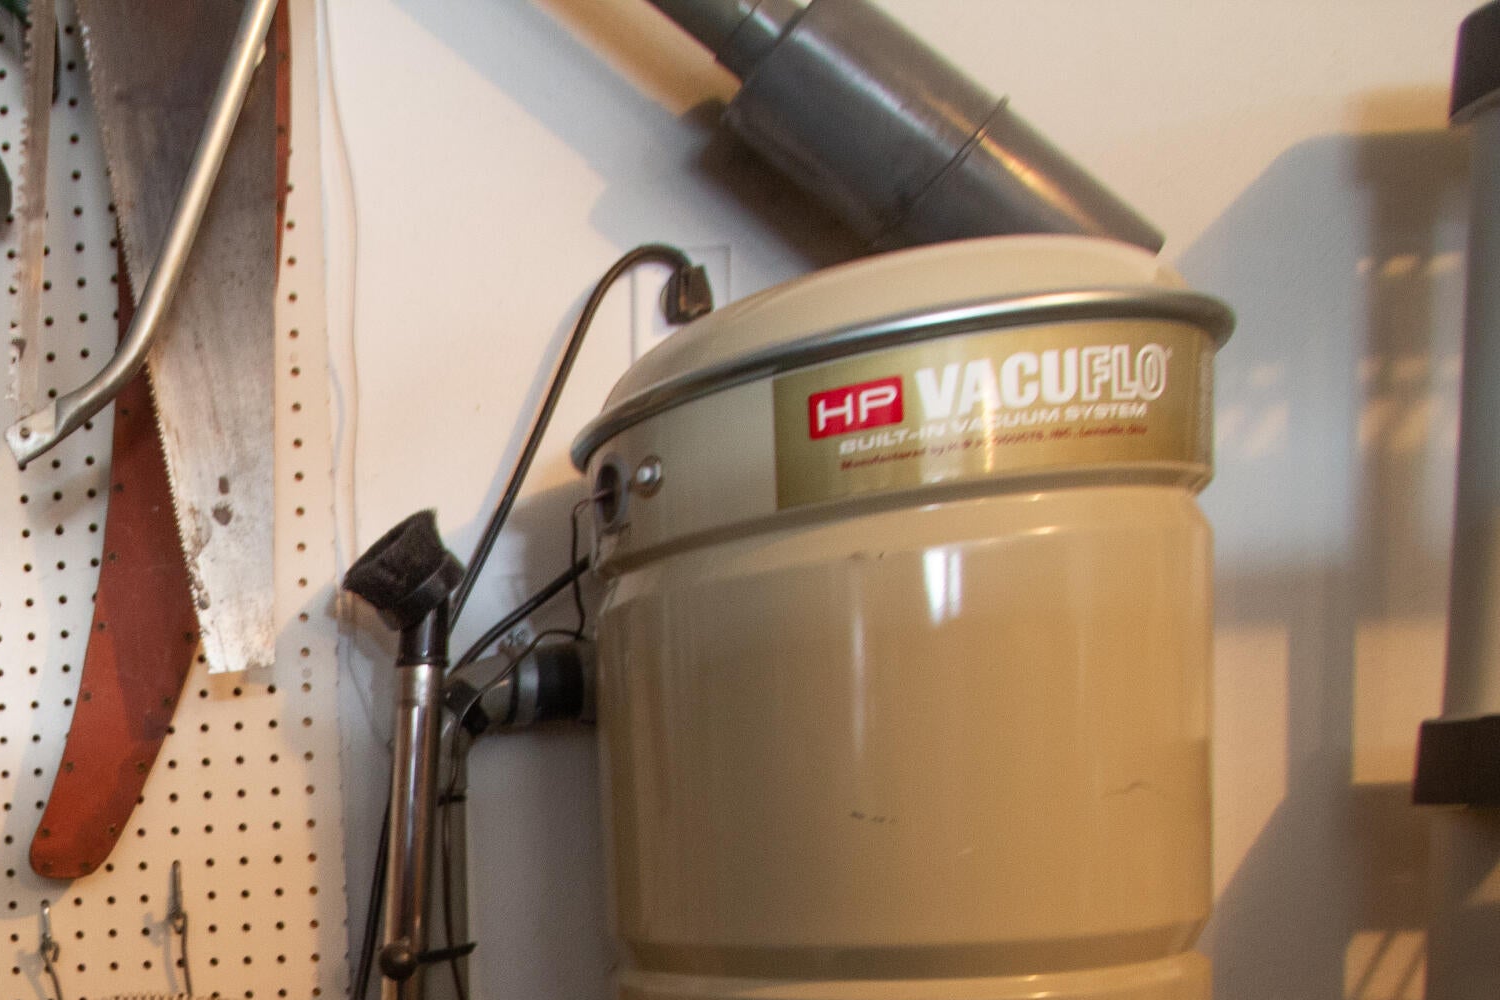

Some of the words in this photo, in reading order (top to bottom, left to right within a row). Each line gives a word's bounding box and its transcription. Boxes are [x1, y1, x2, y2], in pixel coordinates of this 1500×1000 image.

[816, 384, 898, 433] HP
[915, 341, 1168, 421] VACUFLO
[838, 422, 946, 456] BUILT-IN
[950, 407, 1061, 434] VACUUM
[1063, 401, 1148, 423] SYSTEM
